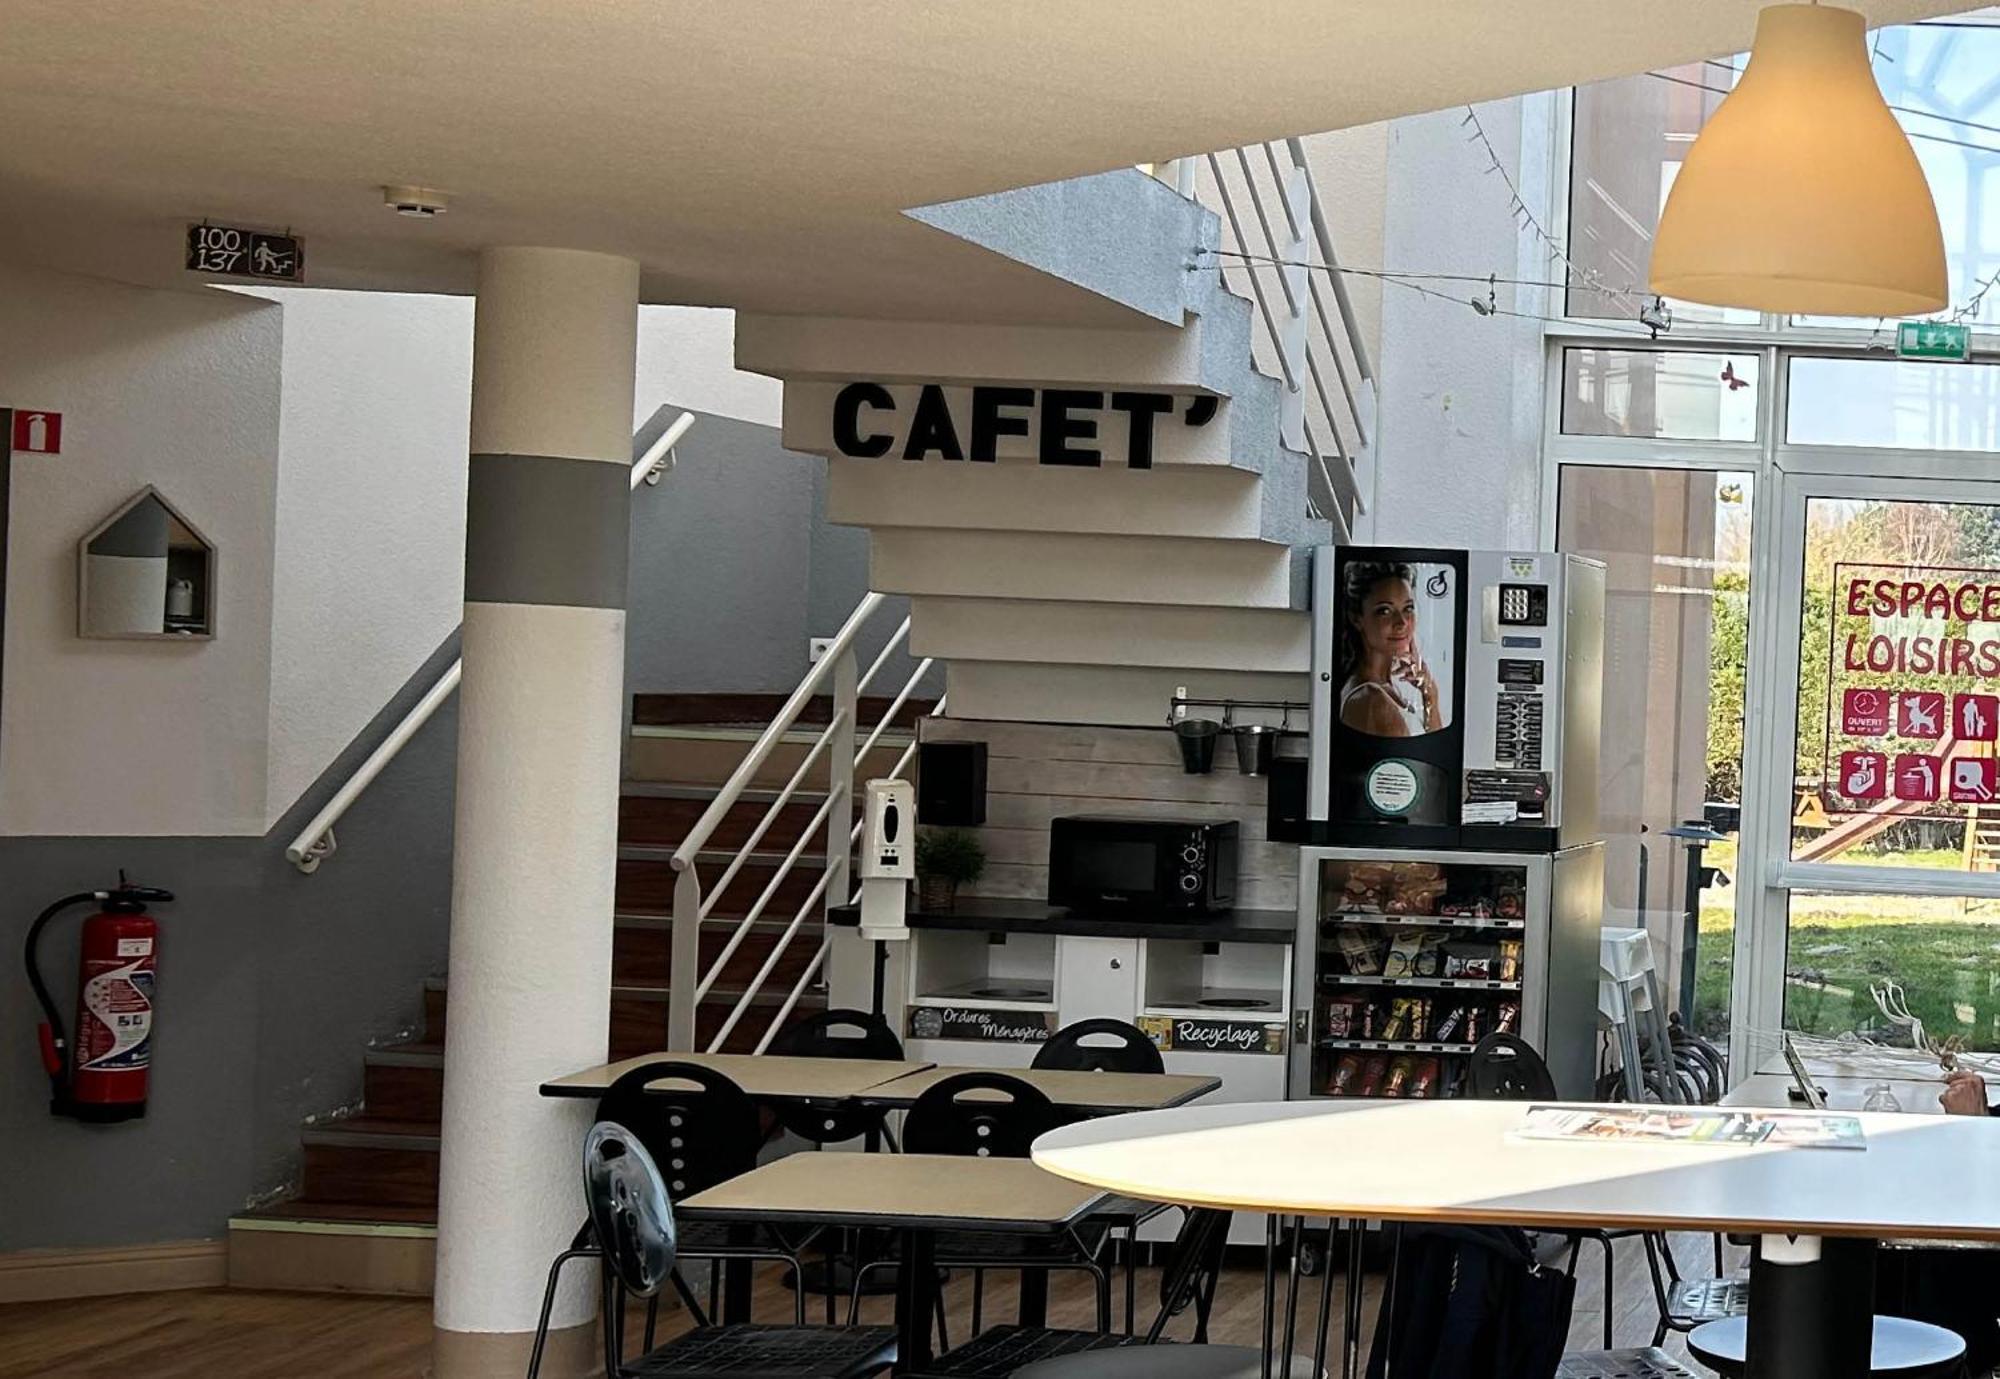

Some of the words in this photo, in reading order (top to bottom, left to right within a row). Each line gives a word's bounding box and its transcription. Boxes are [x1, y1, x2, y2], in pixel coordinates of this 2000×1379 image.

[198, 228, 241, 251] 100
[197, 249, 242, 272] 137
[1847, 578, 2000, 623] ESPACE
[1844, 633, 2000, 678] LOISIRS
[1847, 716, 1883, 727] OUVERT
[943, 1008, 992, 1024] Ordures
[1177, 1020, 1260, 1050] Recyclage
